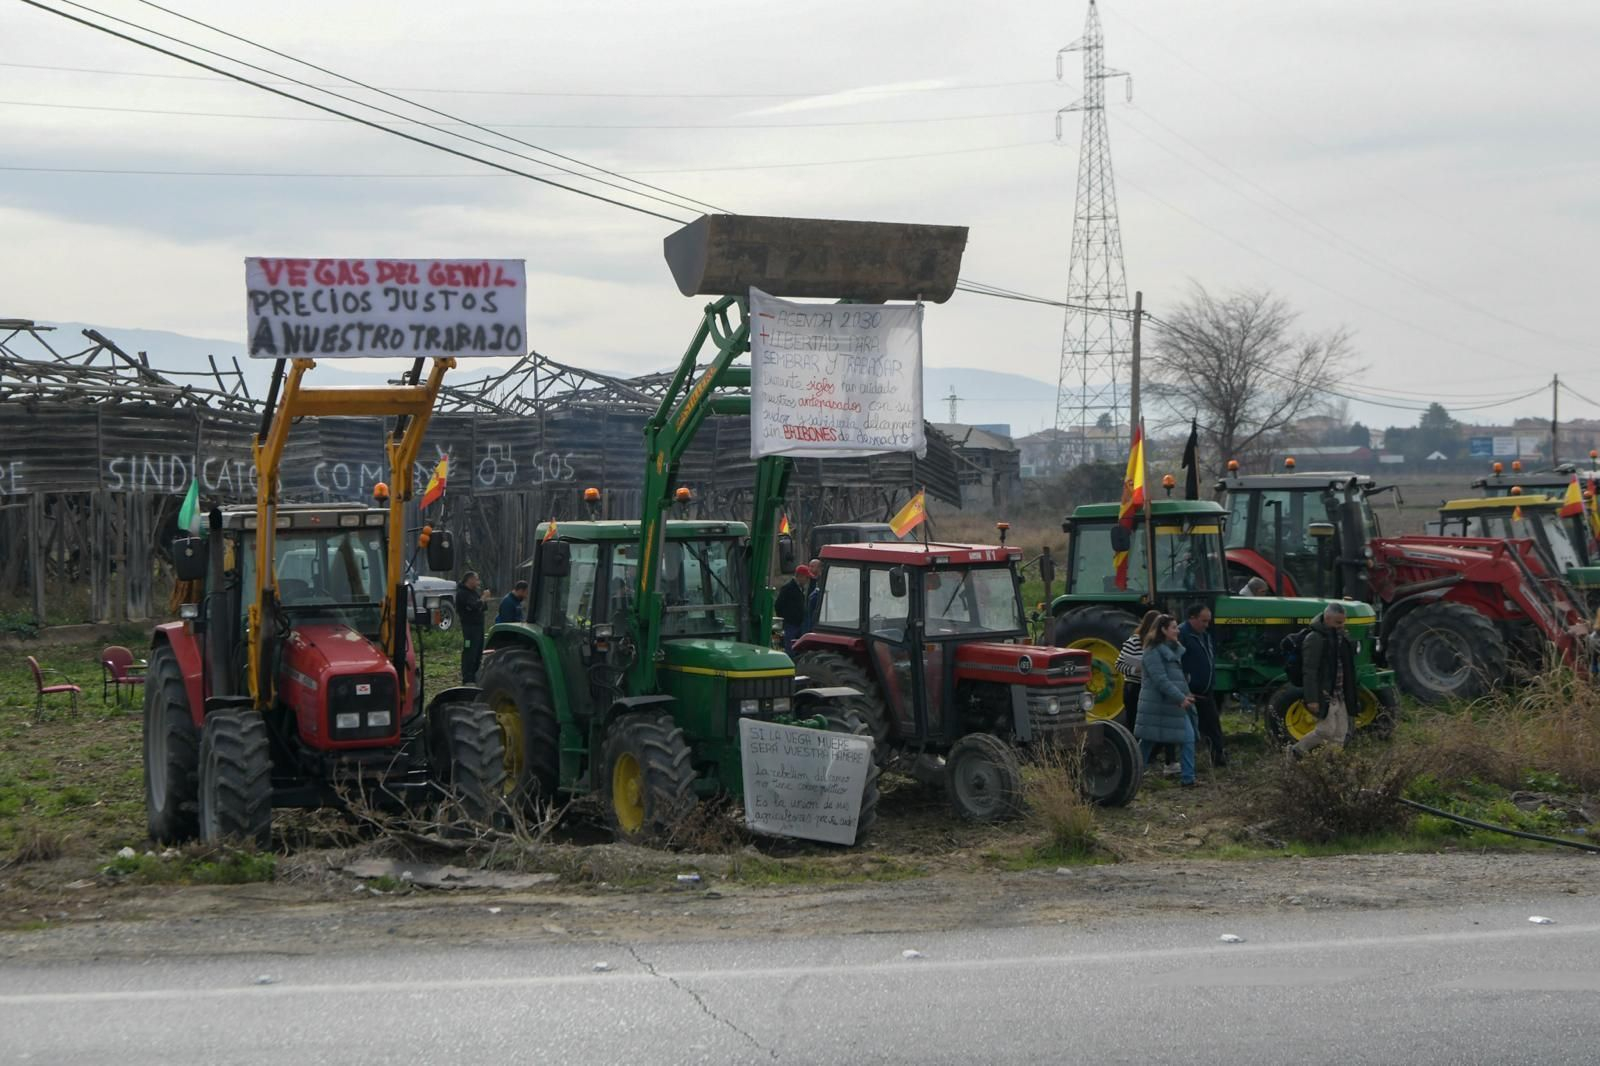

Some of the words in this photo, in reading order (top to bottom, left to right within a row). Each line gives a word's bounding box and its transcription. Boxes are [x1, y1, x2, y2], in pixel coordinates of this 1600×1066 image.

[259, 259, 370, 286] VEGAS
[376, 261, 419, 285] DEL
[427, 262, 516, 287] GENIL
[249, 288, 372, 316] PRECIOS
[384, 288, 498, 313] JUSTOS
[777, 310, 833, 329] AGENDA
[840, 311, 881, 329] 2030
[251, 317, 277, 355] A
[281, 322, 404, 354] NUESTRO
[410, 322, 521, 351] TRABAJO
[848, 335, 880, 353] PARA
[762, 350, 820, 372] SEMBRAR
[806, 375, 835, 397] siglos
[859, 379, 899, 394] cuidado
[798, 394, 862, 413] antepasados
[763, 407, 790, 425] sudor
[763, 423, 781, 438] sin
[783, 424, 838, 442] BRIBONES
[838, 429, 852, 441] de
[750, 727, 764, 740] SI
[784, 730, 812, 746] VEGA
[817, 735, 850, 752] MUERE
